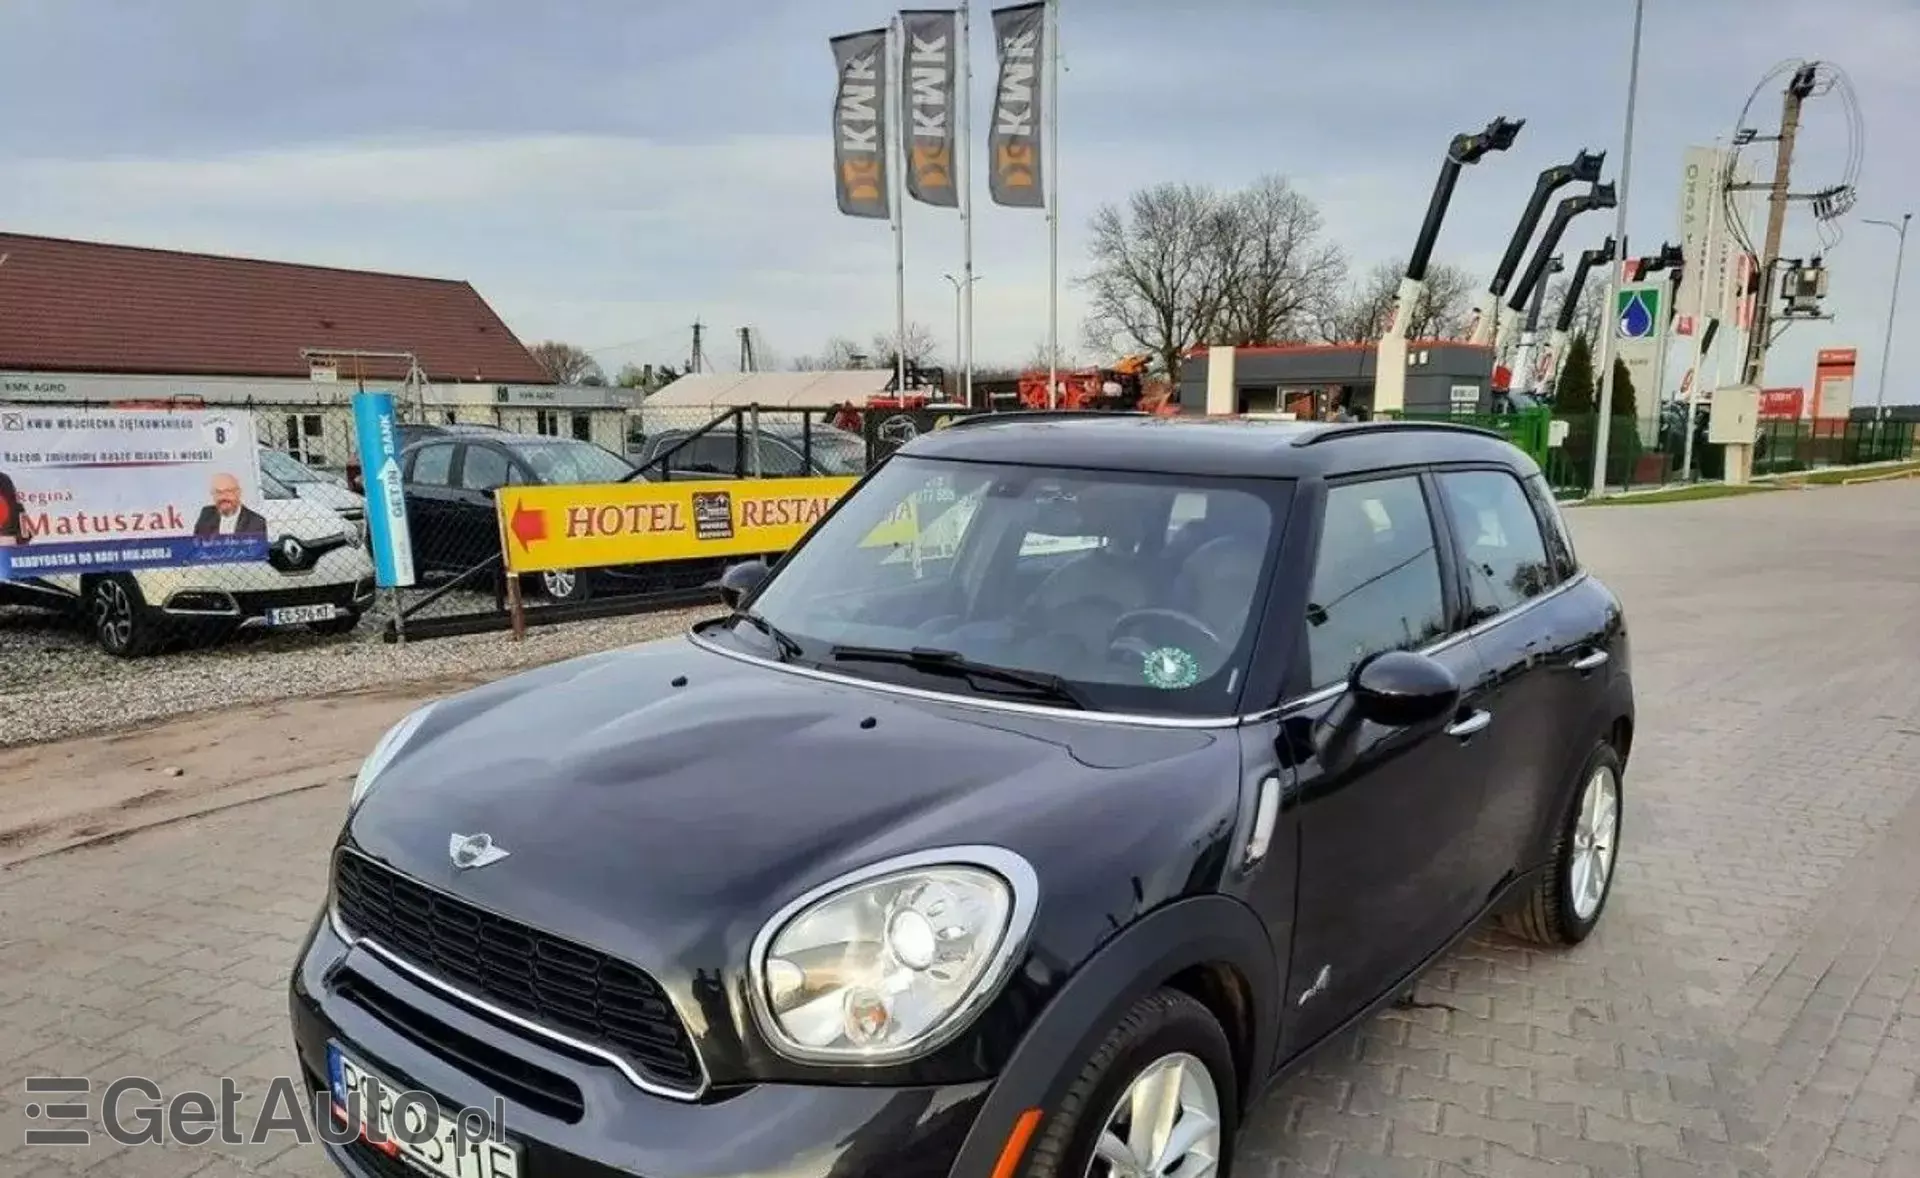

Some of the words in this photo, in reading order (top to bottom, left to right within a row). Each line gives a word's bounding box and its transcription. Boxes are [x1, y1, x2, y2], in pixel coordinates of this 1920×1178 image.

[27, 419, 53, 429] KWW
[215, 426, 226, 444] 8
[379, 414, 395, 456] BANK
[16, 490, 73, 505] Regina
[20, 504, 184, 537] Matuszak
[566, 503, 686, 538] HOTEL
